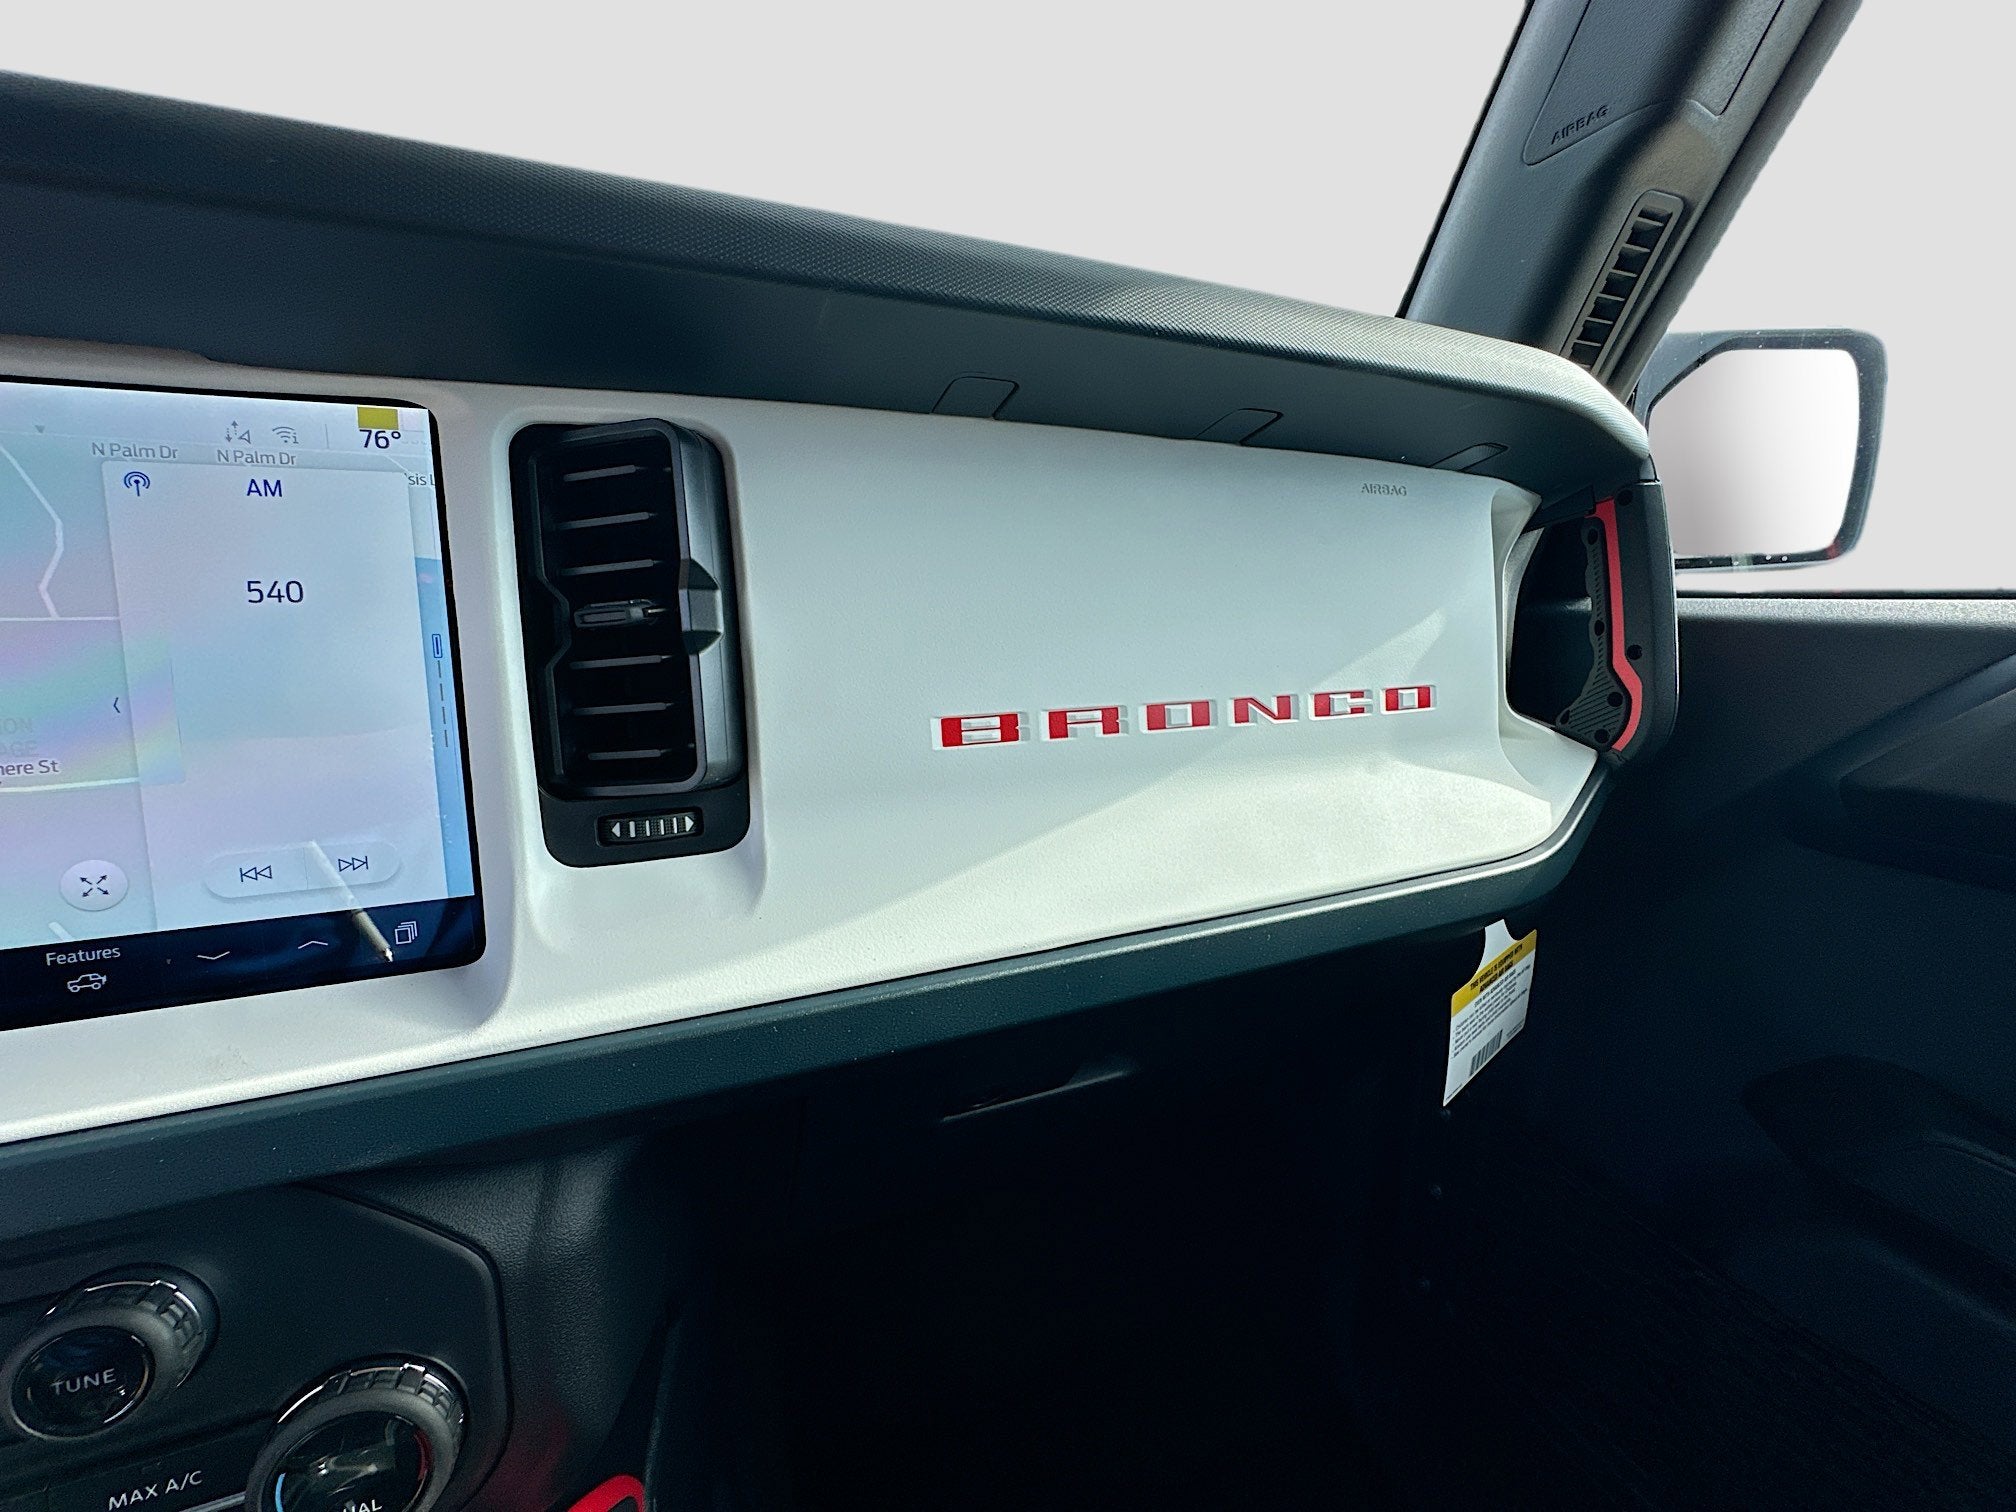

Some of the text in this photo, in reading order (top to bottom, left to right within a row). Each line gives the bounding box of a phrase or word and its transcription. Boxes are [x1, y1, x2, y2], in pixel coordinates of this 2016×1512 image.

[1551, 104, 1608, 145] AIRBAG
[359, 429, 401, 449] 76°
[91, 442, 178, 459] N Palm Dr
[217, 449, 297, 465] N Palm Dr
[246, 478, 283, 497] AM
[404, 473, 427, 486] sis
[1361, 482, 1407, 497] AIRBAG
[246, 580, 304, 603] 540
[931, 684, 1437, 751] BRONCO
[38, 759, 59, 774] St
[45, 945, 121, 966] Features
[50, 1368, 117, 1396] TUNE
[108, 1470, 202, 1511] MAX A/C
